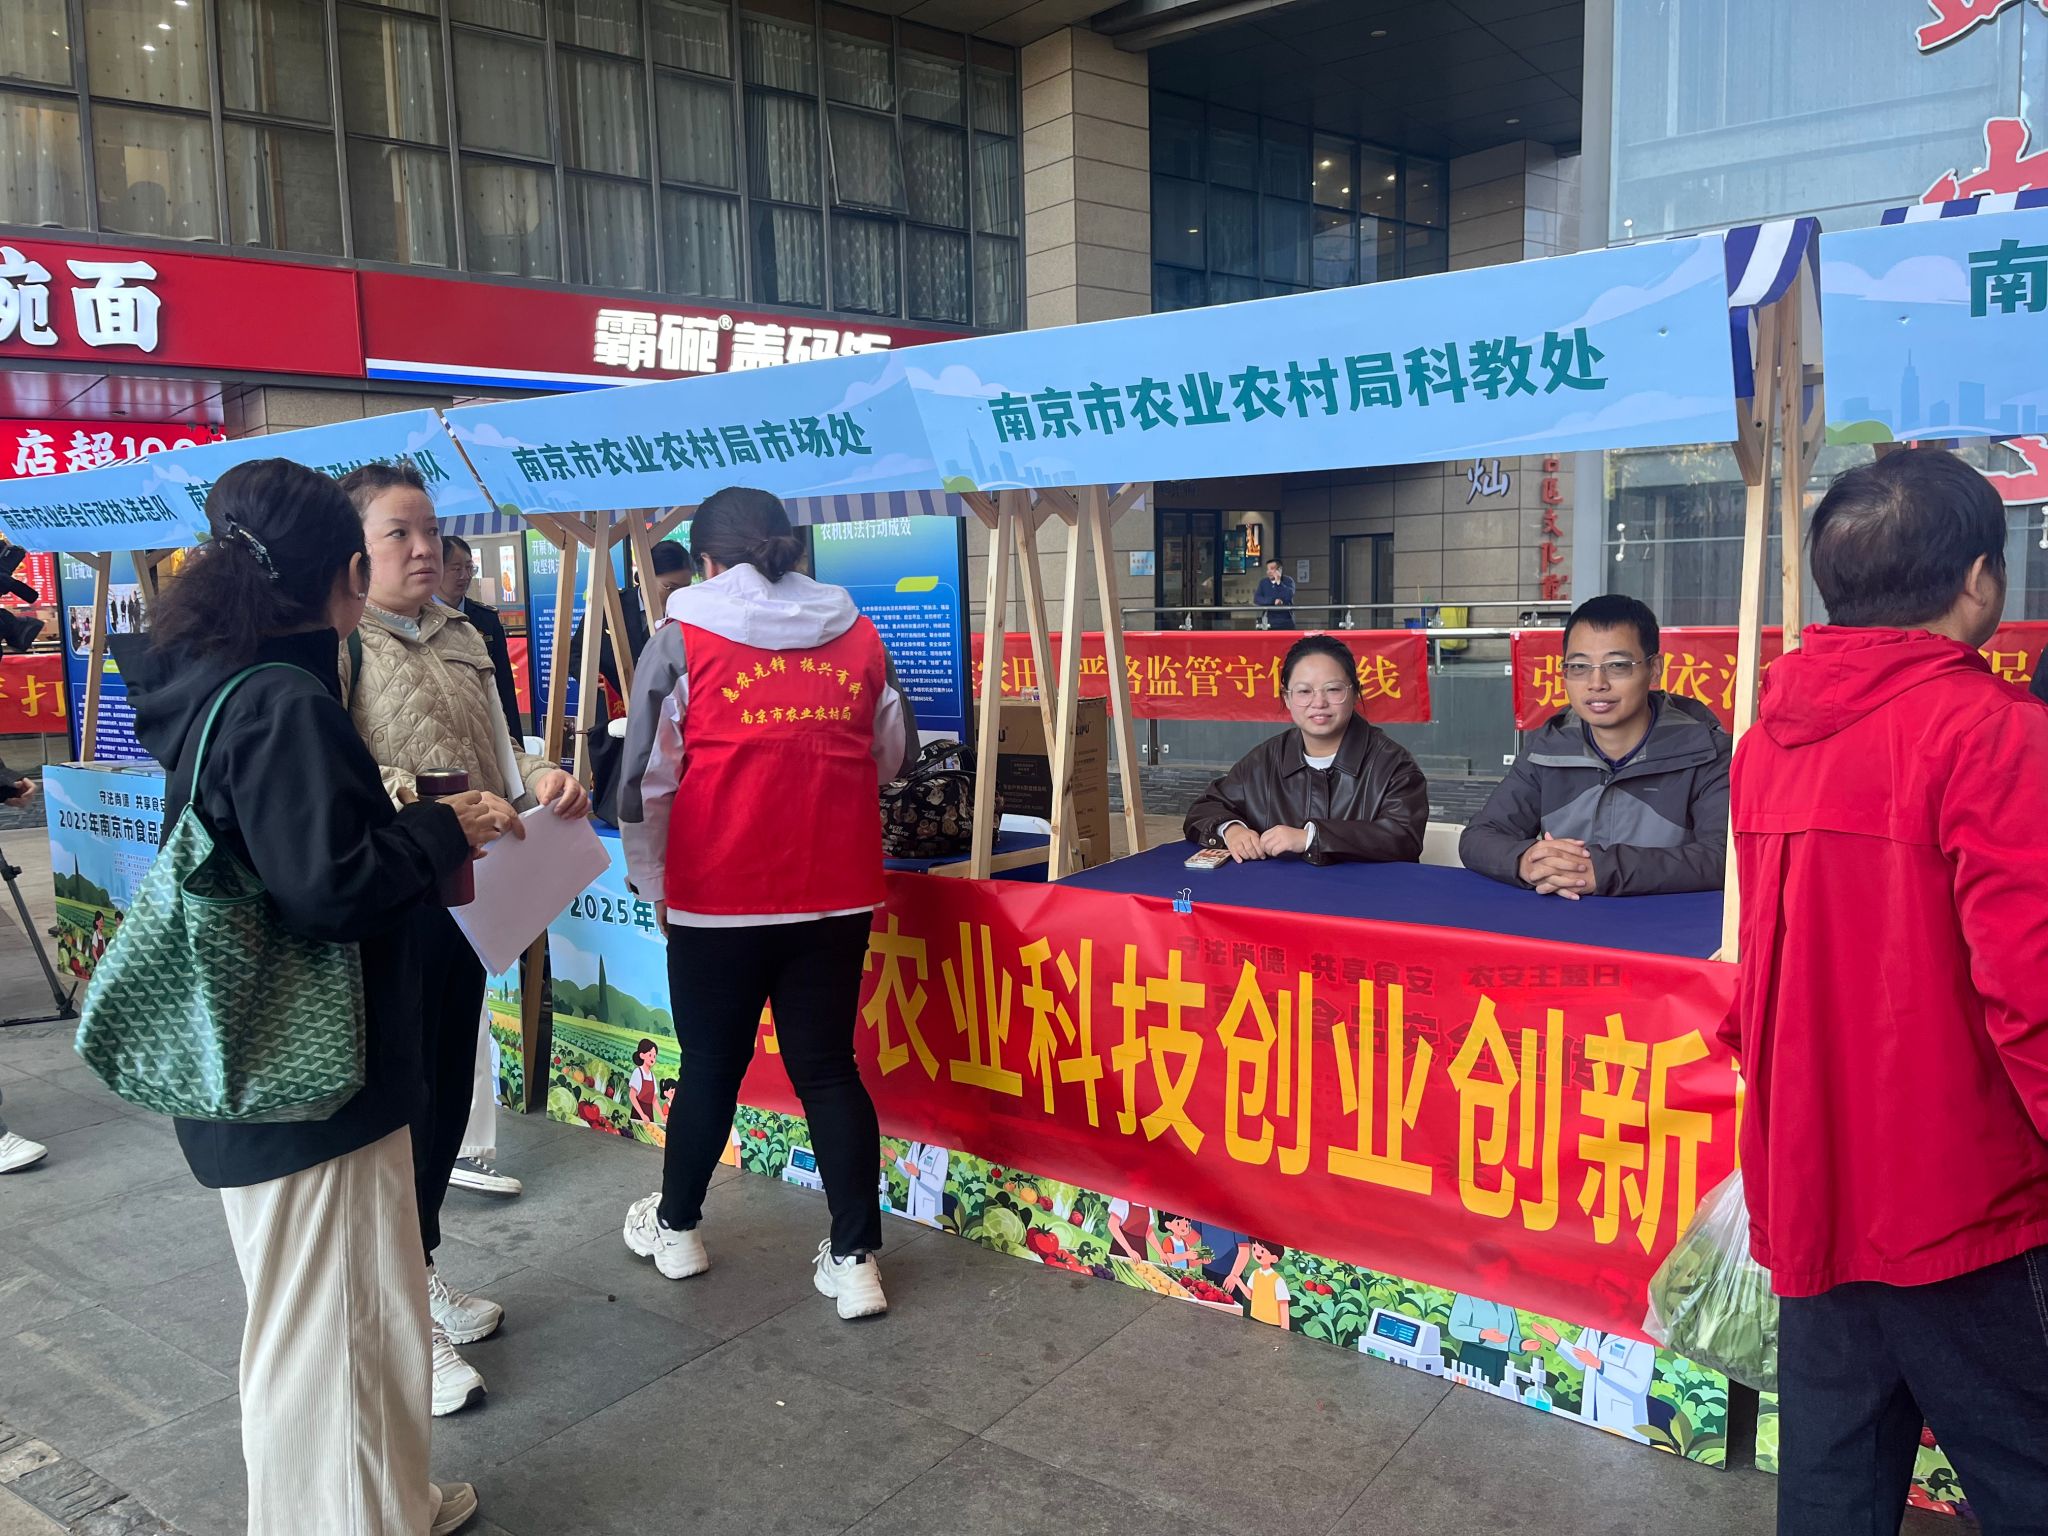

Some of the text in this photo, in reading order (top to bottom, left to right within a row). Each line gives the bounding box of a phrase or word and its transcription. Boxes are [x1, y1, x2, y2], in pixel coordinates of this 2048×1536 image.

[988, 327, 1609, 443] 南京市农业农村局科教处
[512, 411, 873, 483] 南京市农业农村局市场处
[0, 494, 178, 531] 南京市农业综合行政执法总队
[820, 517, 912, 541] 农机执法行动成效
[0, 674, 66, 718] 打
[740, 705, 852, 725] 南京市农业农村局
[99, 790, 130, 809] 守法尚德
[59, 809, 163, 845] 2025年南京市食品
[1310, 952, 1434, 996] 共享食安
[753, 912, 1742, 1256] 农业科技创业创新
